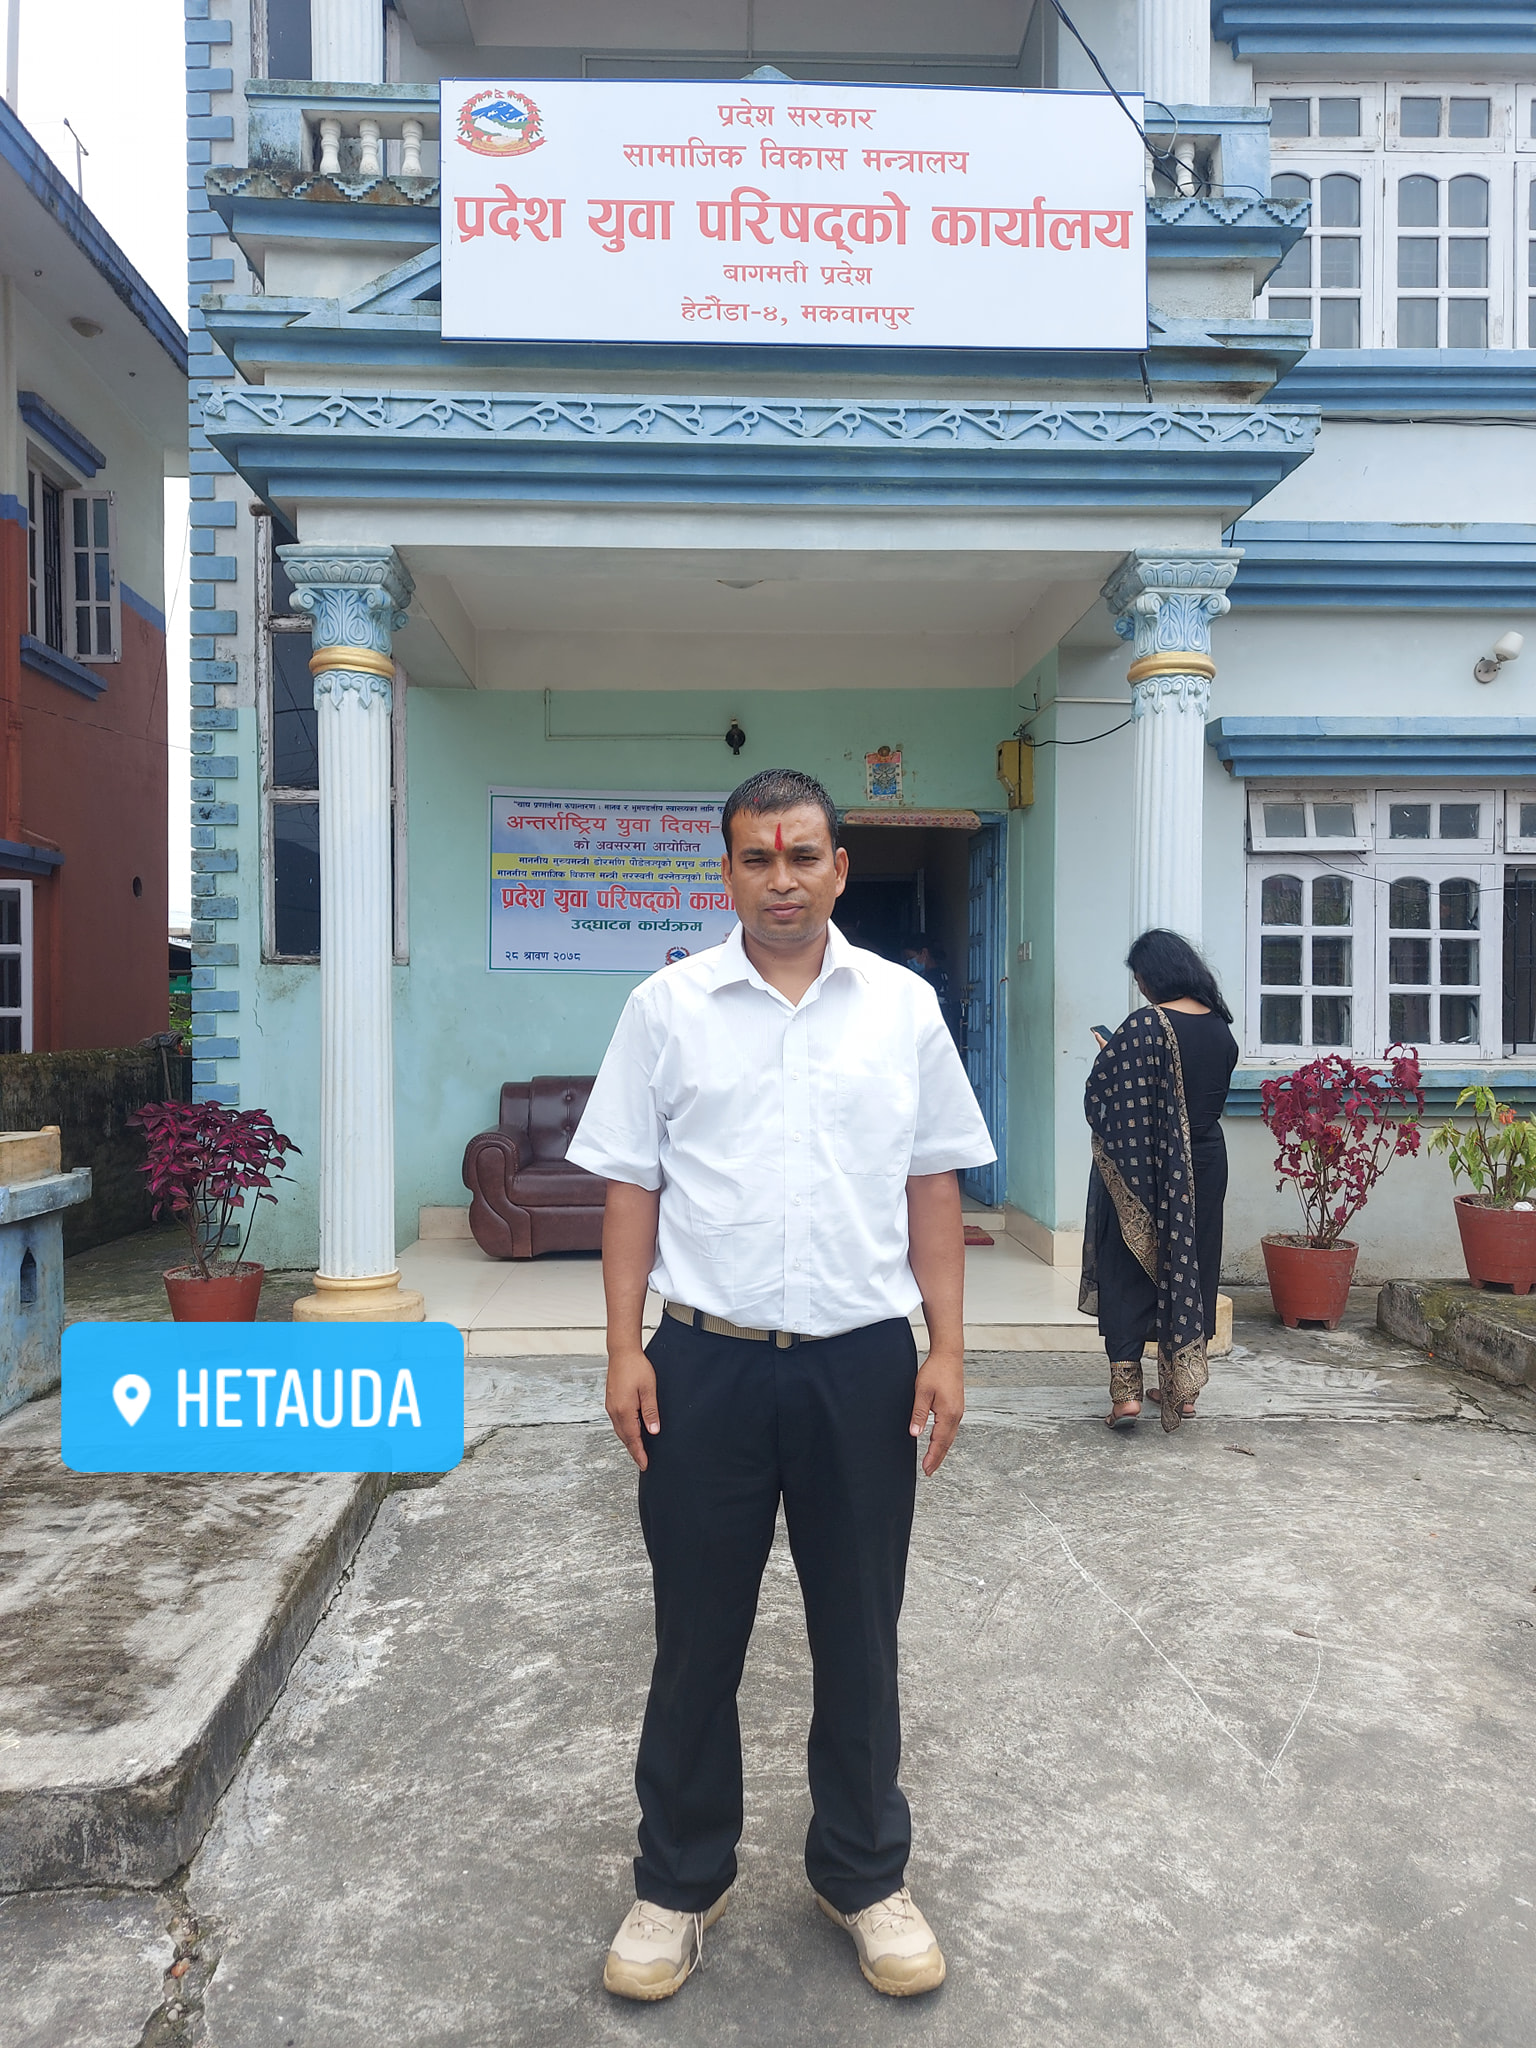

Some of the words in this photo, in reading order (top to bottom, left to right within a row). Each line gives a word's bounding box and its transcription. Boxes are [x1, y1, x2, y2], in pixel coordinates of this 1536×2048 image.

[717, 97, 775, 128] प्रदेश
[787, 105, 877, 130] सरकार
[622, 136, 747, 168] सामाजिक
[761, 136, 848, 170] विकास
[862, 147, 970, 175] मन्त्रालय
[453, 183, 566, 243] प्रदेश
[588, 197, 675, 253] युवा
[696, 186, 911, 254] परिषद्को
[931, 196, 1134, 250] कार्यालय
[722, 261, 809, 285] बागमती
[820, 260, 873, 286] प्रदेश
[801, 302, 914, 330] मकवानपुर
[506, 812, 607, 834] अन्तर्राष्ट्रिय
[617, 819, 650, 836] युवा
[573, 838, 590, 850] को
[596, 841, 646, 852] अवसरमा
[653, 840, 701, 853] आयोजित
[519, 856, 548, 865] माननीय
[497, 869, 527, 878] माननीय
[531, 869, 565, 879] सामाजिक
[570, 870, 595, 879] विकास
[599, 870, 618, 880] मन्त्री
[623, 872, 654, 880] सरस्वती
[501, 883, 545, 910] प्रदेश
[554, 889, 588, 913] युवा
[597, 885, 681, 914] परिषद्को
[638, 918, 703, 932] कार्यक्रम
[505, 951, 518, 960] २८
[523, 951, 549, 961] श्रावण
[553, 952, 581, 961] २०७८
